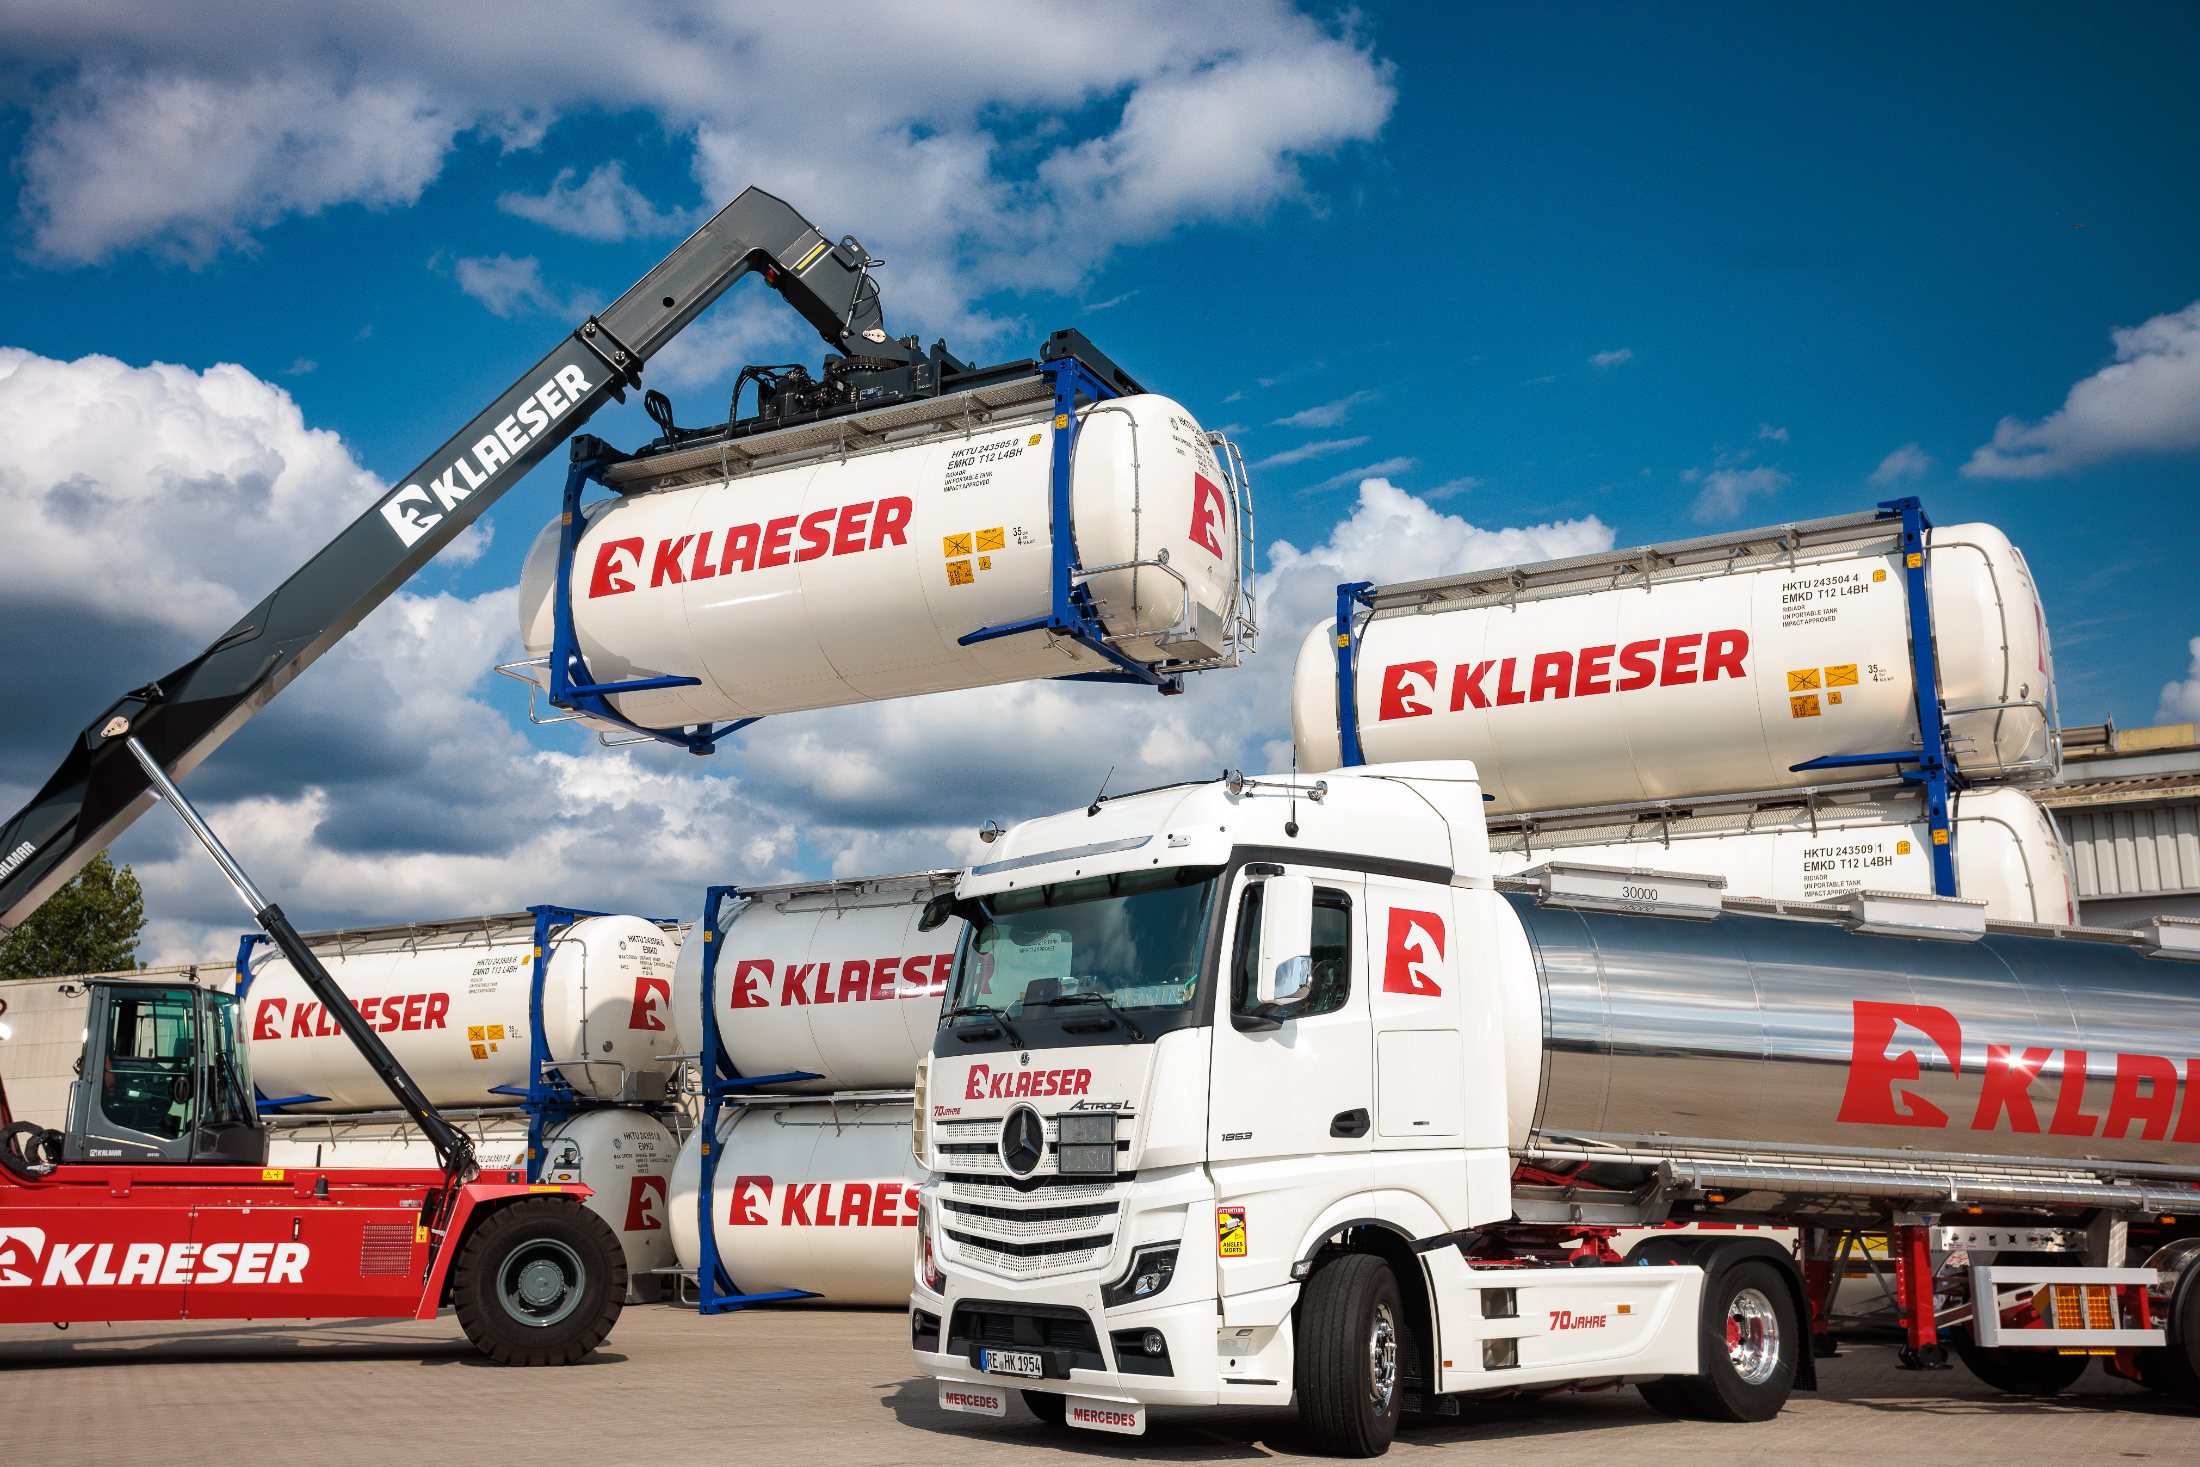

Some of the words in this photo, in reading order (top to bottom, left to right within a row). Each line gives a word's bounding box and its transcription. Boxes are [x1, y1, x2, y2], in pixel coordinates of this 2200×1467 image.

[429, 364, 593, 512] KLAESER
[947, 456, 975, 470] EMKD
[979, 453, 996, 464] T12
[998, 447, 1024, 460] L4BH
[951, 446, 979, 459] HKTU
[978, 440, 1011, 454] 243505
[650, 495, 913, 588] KLAESER
[1782, 580, 1811, 592] HKTU
[1813, 575, 1850, 588] 243504
[1852, 573, 1859, 582] 4
[1782, 591, 1813, 604] EMKD
[1818, 588, 1836, 599] T12
[1840, 583, 1869, 596] L4BH
[1782, 620, 1803, 628] IMPACT
[1804, 615, 1836, 625] APPROVED
[1791, 609, 1821, 619] PORTABLE
[1823, 607, 1838, 615] TANK
[1449, 628, 1749, 713] KLAESER
[1867, 664, 1879, 674] 35
[1872, 673, 1879, 683] 4
[0, 841, 37, 880] ALMAR
[1803, 847, 1833, 859] HKTU
[1835, 844, 1873, 857] 243509
[1878, 843, 1883, 853] 1
[1803, 860, 1836, 872] EMKD
[1840, 858, 1859, 869] T12
[1863, 855, 1893, 868] L4BH
[1622, 886, 1658, 901] 30000
[1804, 890, 1826, 898] IMPACT
[1813, 881, 1845, 889] PORTABLE
[472, 967, 490, 976] EMKD
[988, 1068, 1092, 1099] KLAESER
[1221, 1131, 1253, 1142] 1853
[781, 1183, 925, 1226] KLAES
[41, 1242, 310, 1286] KLAESER
[1549, 1310, 1571, 1331] 70
[1571, 1315, 1607, 1330] JAHRE
[986, 1352, 999, 1369] RE
[1004, 1353, 1016, 1371] HK
[1017, 1355, 1041, 1373] 1954
[945, 1392, 999, 1410] MERCEDES
[1073, 1407, 1136, 1427] MERCEDES
